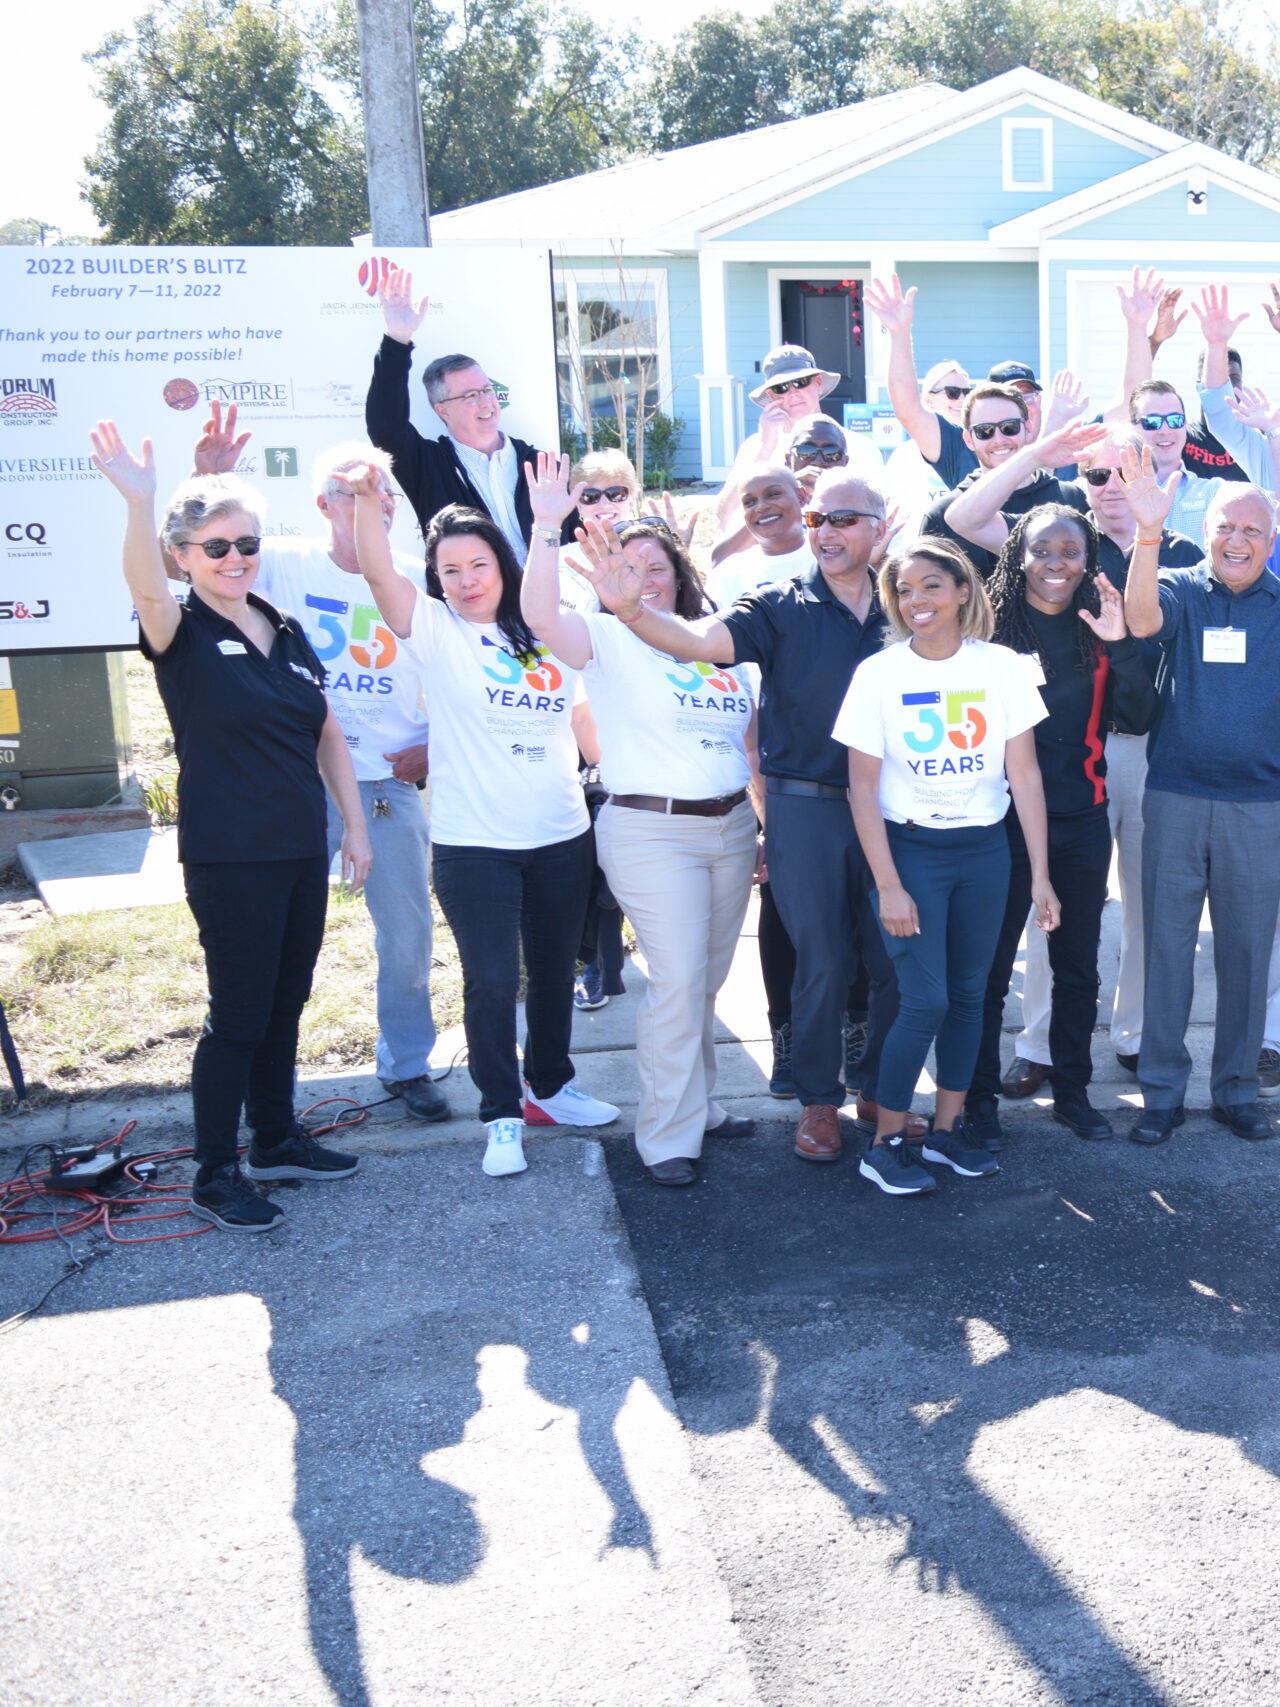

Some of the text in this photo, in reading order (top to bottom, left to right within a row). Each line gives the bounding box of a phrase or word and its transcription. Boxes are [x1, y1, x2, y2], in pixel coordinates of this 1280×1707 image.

[25, 257, 248, 275] 2022 BUILDER'S BLITZ
[51, 284, 123, 300] February
[184, 284, 222, 298] 2022
[0, 326, 283, 344] Thank you to our partners who have
[41, 347, 242, 364] made this home possible!
[0, 378, 56, 403] ORUM
[205, 384, 288, 401] EMPIRE
[0, 411, 58, 420] ONSTRUCTION
[5, 522, 47, 545] CQ
[8, 550, 53, 558] Insulation
[485, 686, 566, 713] YEARS
[672, 691, 748, 713] YEARS
[902, 689, 987, 753] 35
[907, 753, 984, 777] YEARS
